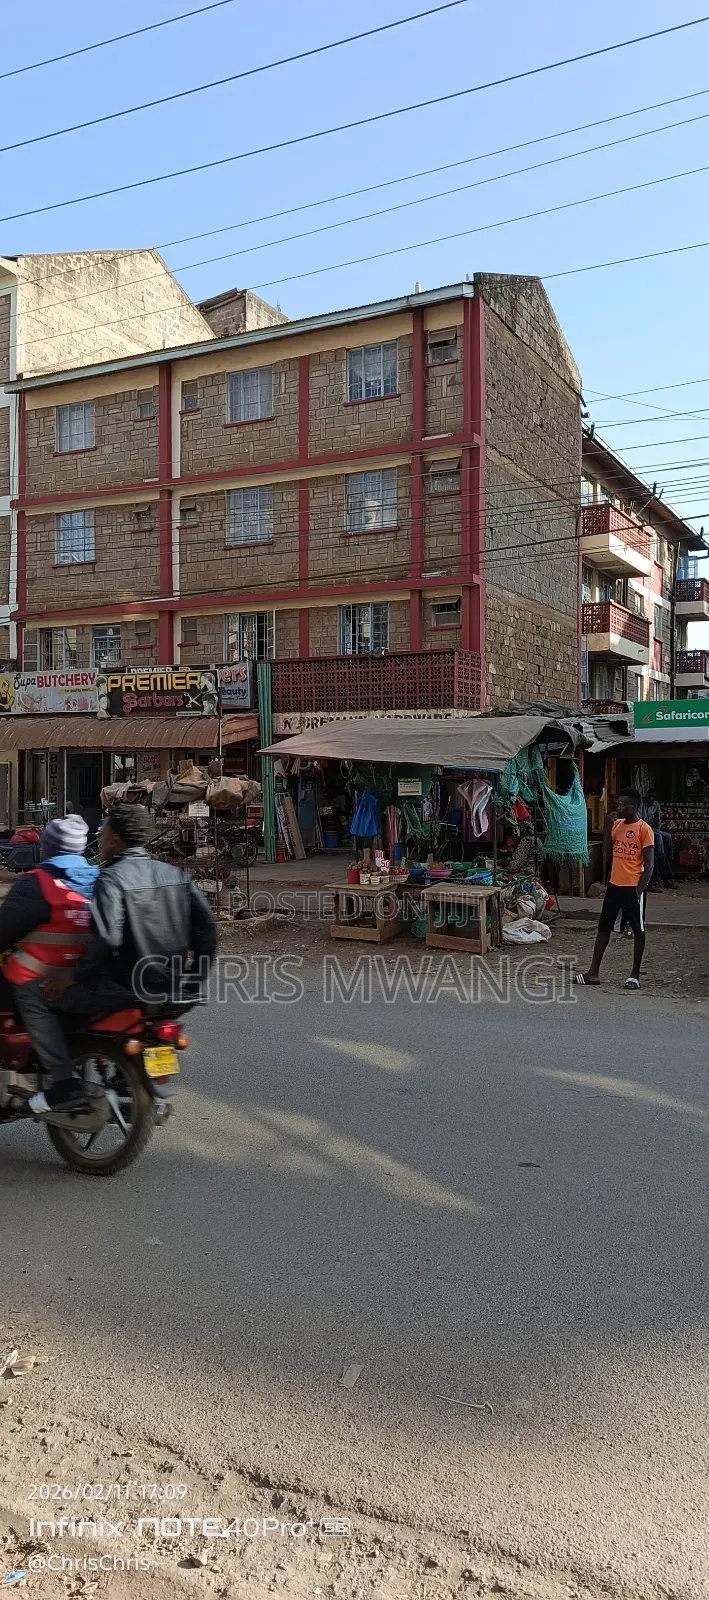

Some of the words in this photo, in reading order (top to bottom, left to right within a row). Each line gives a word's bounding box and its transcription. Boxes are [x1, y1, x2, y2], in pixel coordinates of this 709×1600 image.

[14, 673, 36, 691] Supa
[36, 672, 96, 688] BUTCHERY
[107, 672, 202, 693] PREMIER
[221, 687, 248, 697] eauty
[122, 692, 184, 713] Barbers
